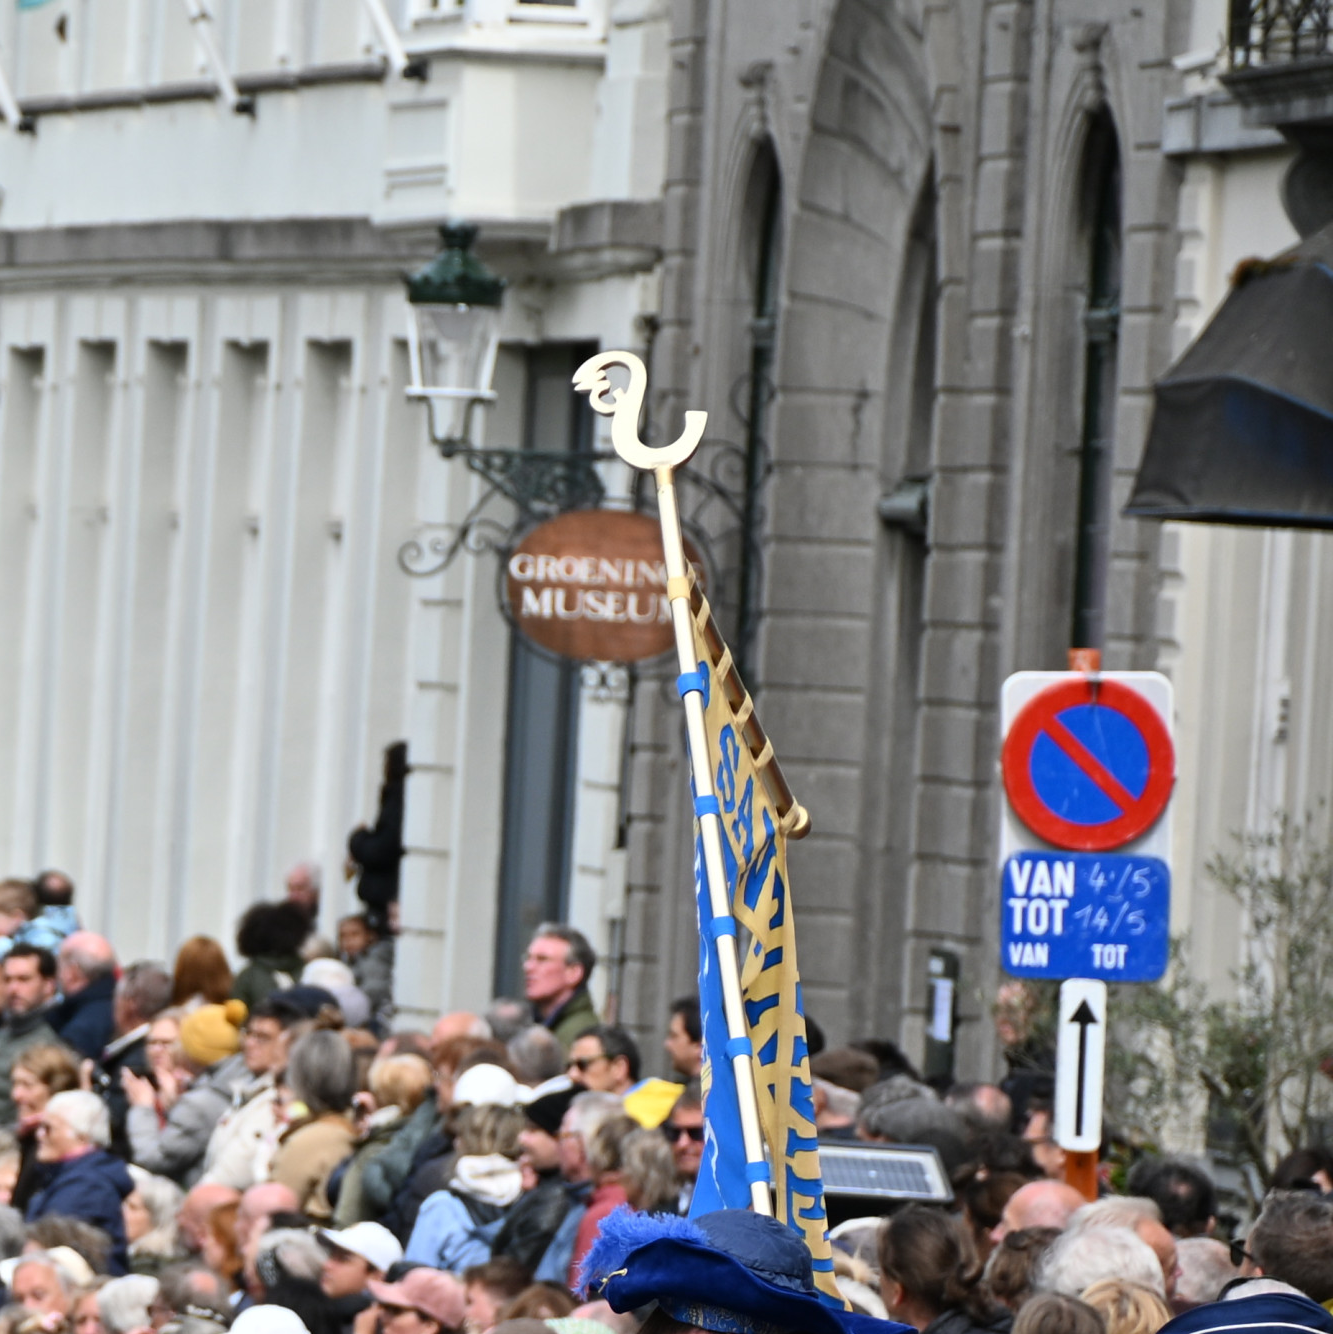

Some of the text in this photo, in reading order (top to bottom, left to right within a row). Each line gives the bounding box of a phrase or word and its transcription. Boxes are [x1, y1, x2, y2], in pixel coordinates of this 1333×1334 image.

[508, 552, 704, 590] GROENIN
[1009, 859, 1075, 897] VAN
[1008, 897, 1070, 935] TOT
[1009, 941, 1128, 970] VAN TOT
